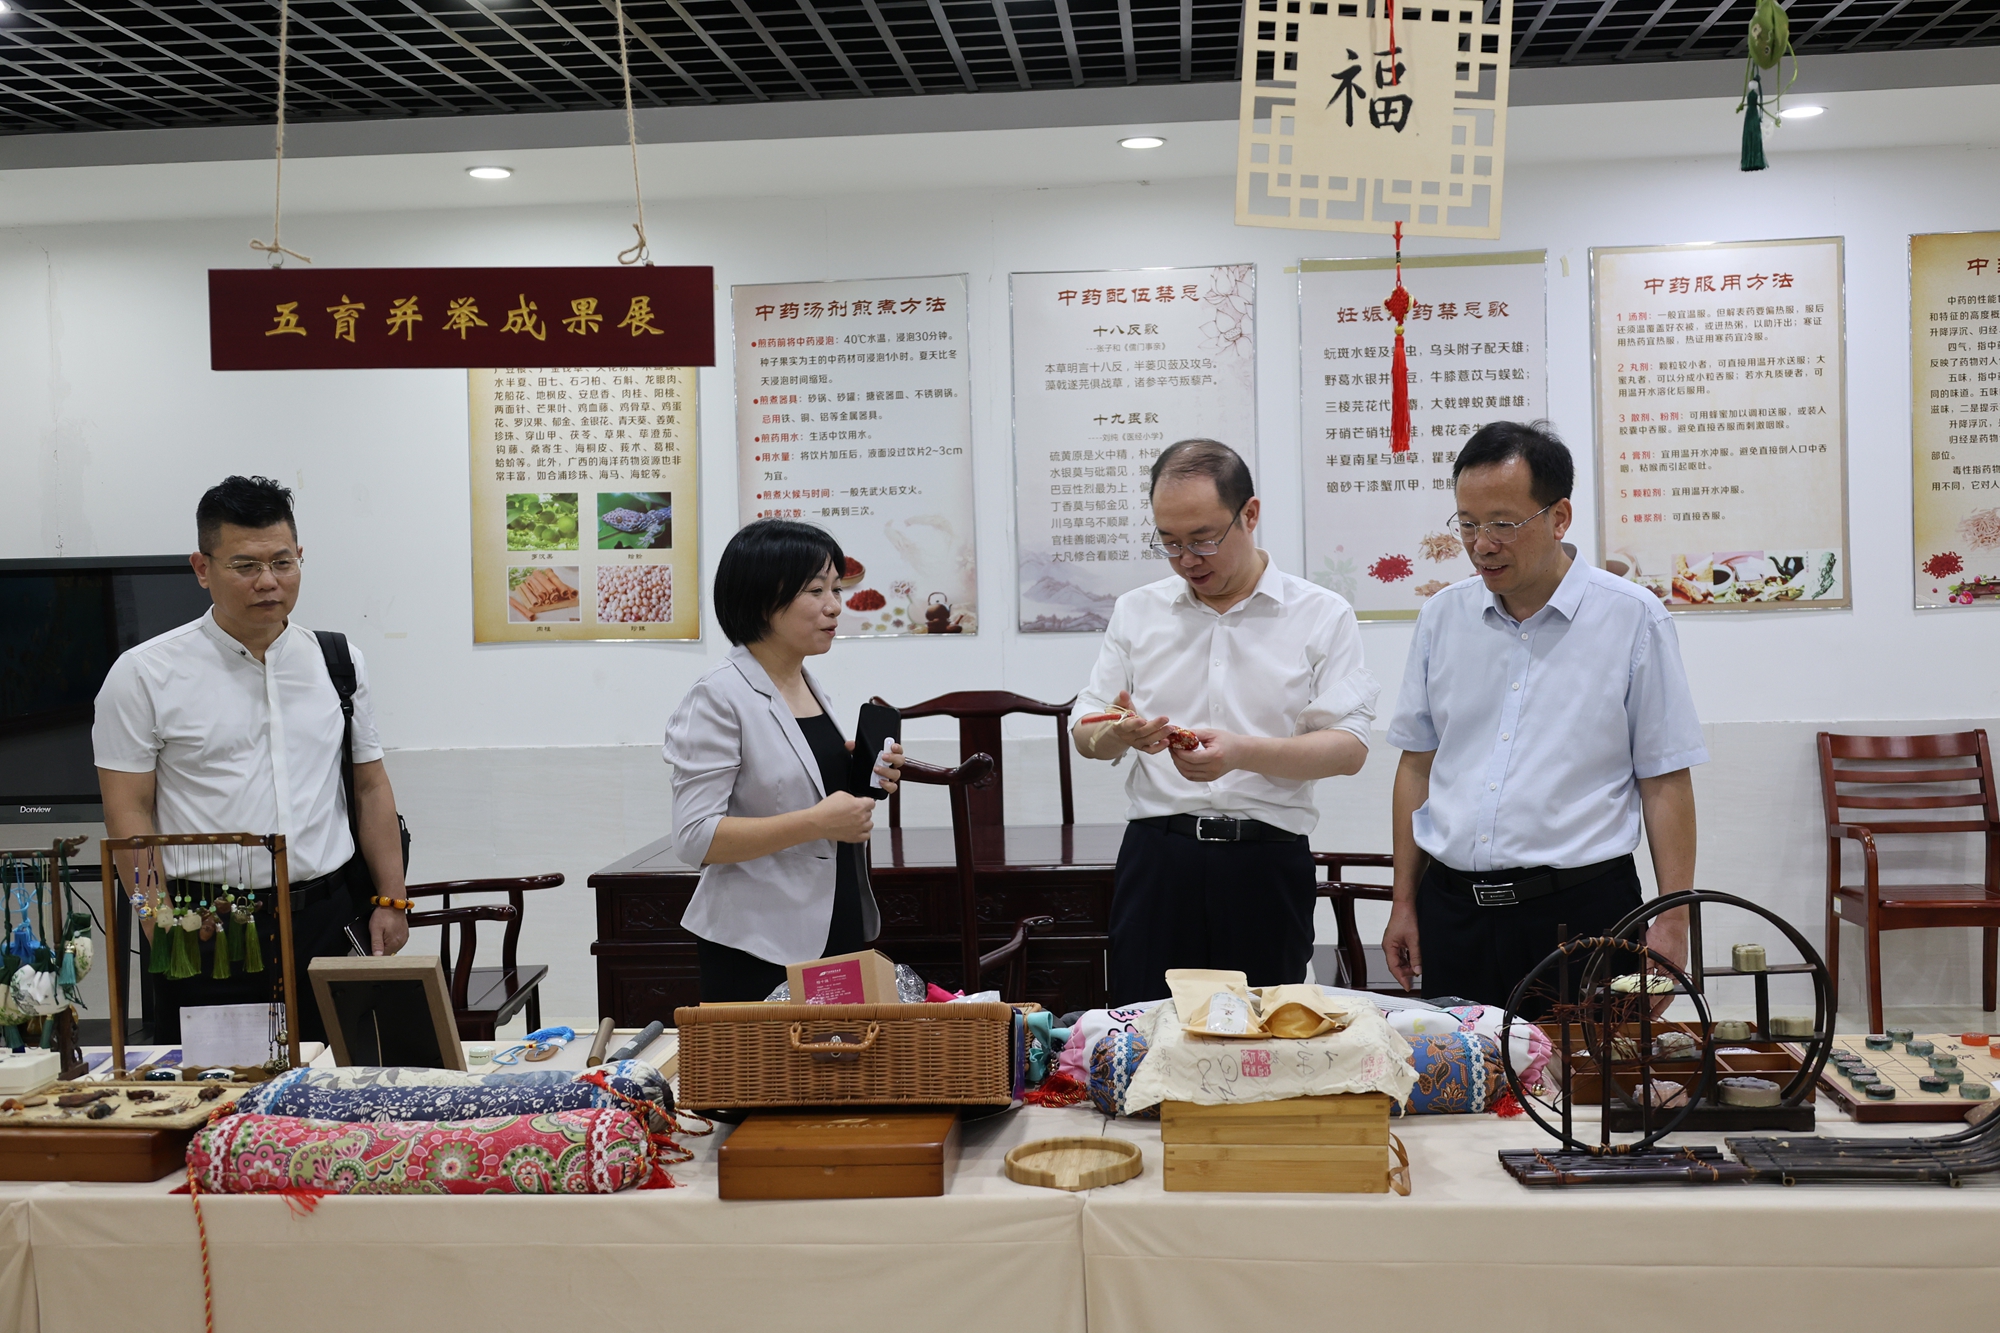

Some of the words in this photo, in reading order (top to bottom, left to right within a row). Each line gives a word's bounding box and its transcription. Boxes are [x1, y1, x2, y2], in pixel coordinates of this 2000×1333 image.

[1325, 47, 1413, 133] 福
[1967, 258, 2000, 275] 中
[1644, 272, 1794, 295] 中药服用方法
[1058, 284, 1200, 306] 中药配伍禁忌
[1948, 294, 2000, 305] 中药的性能
[755, 296, 947, 321] 中药汤剂煎煮方法
[1337, 301, 1509, 323] 妊娠药禁忌歌
[265, 293, 665, 343] 五育并举成果展
[1093, 323, 1159, 337] 十八反歌
[1930, 325, 2000, 337] 升降浮沉、归经
[1324, 341, 1530, 360] 蚖斑水蛭及虫，乌头附子配天雄；
[1948, 341, 2000, 351] 四气，指中
[1930, 356, 2000, 368] 反映了药物对人
[761, 374, 833, 386] 天浸泡时间缩短。
[1325, 368, 1531, 386] 野葛水银并豆，牛膝薏苡与蜈蚣；
[1948, 371, 2000, 383] 五味，指中
[1618, 385, 1711, 398] 用温开水溶化后服用。
[1930, 387, 2000, 399] 同的味道。五味
[1325, 395, 1531, 413] 三棱芫花代麝，大戟蝉蜕黄雌雄；
[1930, 403, 2000, 414] 滋味，二是提示
[1948, 418, 2000, 429] 升降浮沉，
[761, 430, 872, 443] 煎药用水：生活中饮用水。
[1948, 434, 2000, 444] 归经是药物
[1931, 451, 1956, 461] 部位。
[764, 471, 788, 481] 为宜。
[763, 485, 923, 500] 煎煮火候与时间：一般先武火后文火。
[1633, 485, 1745, 497] 颗粒剂：宜用温开水冲服。
[20, 805, 51, 813] Donview
